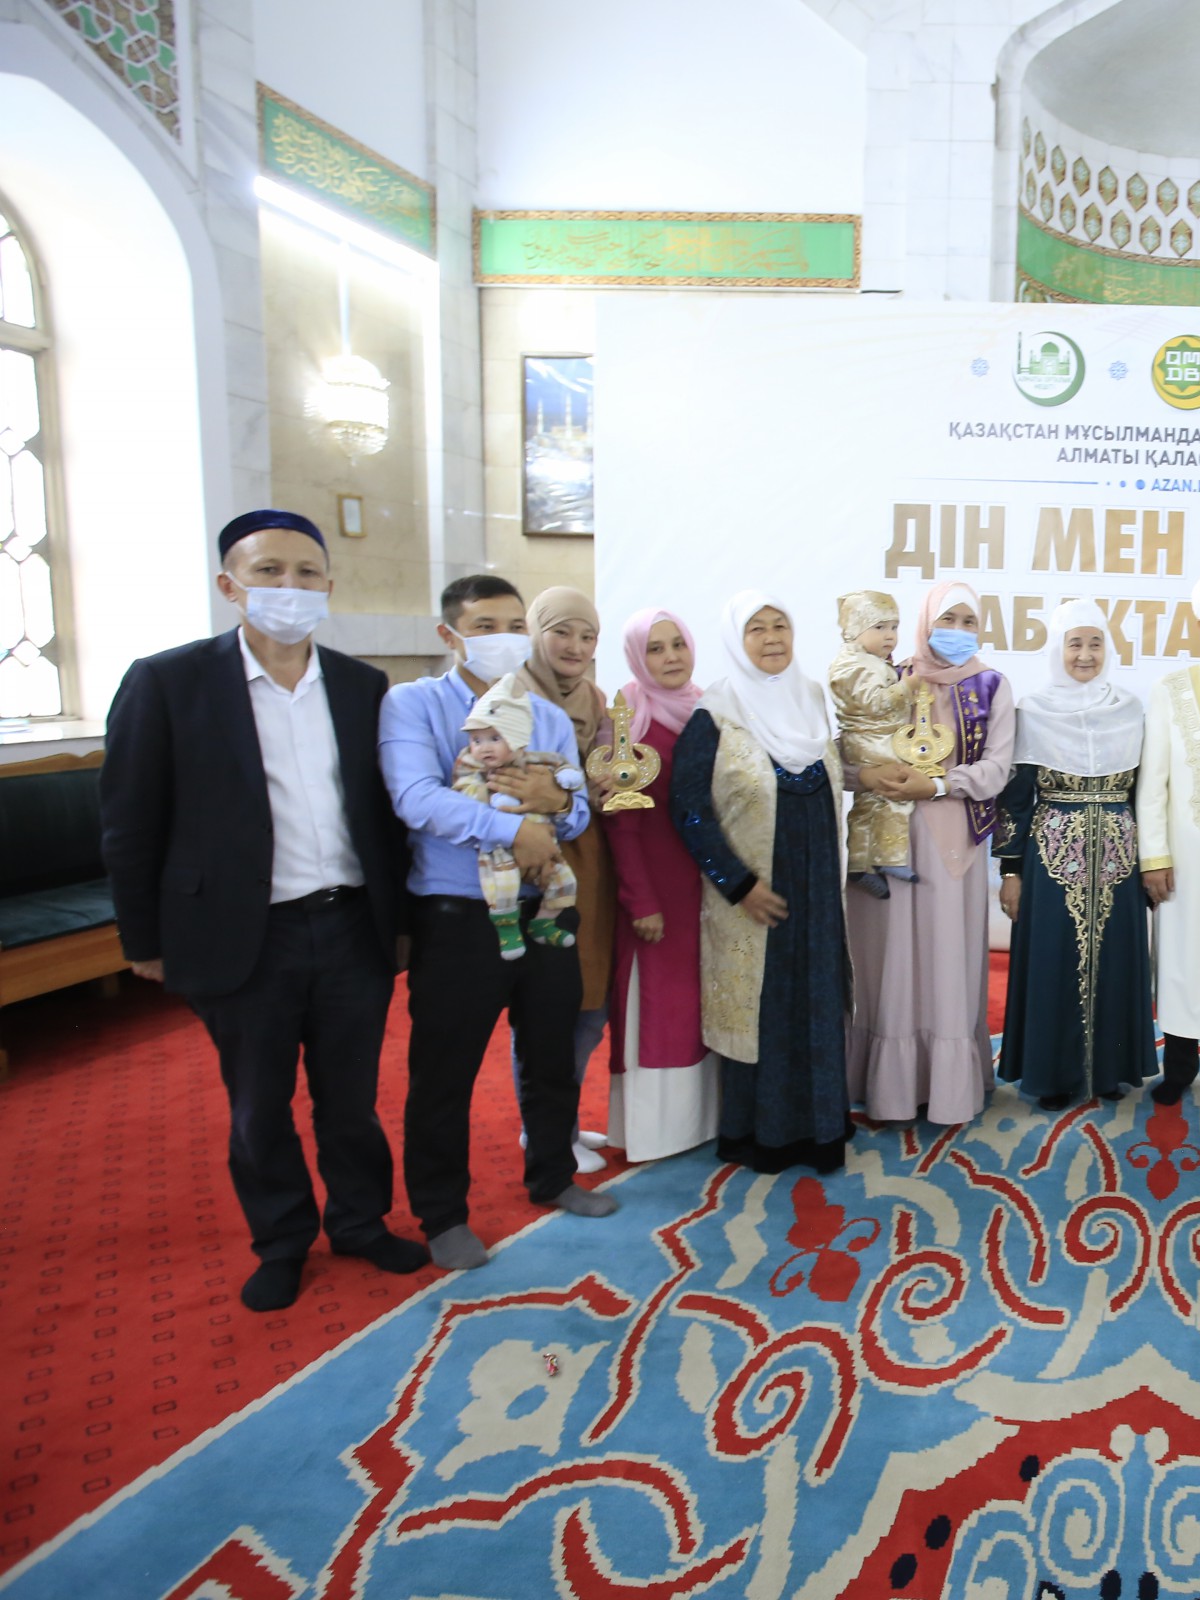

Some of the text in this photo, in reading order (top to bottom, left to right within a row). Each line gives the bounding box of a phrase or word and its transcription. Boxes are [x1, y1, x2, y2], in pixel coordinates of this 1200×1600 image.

[949, 421, 1059, 441] ҚАЗАҚСТАН
[1057, 447, 1140, 465] АЛМАТЫ
[885, 503, 1005, 580] ДІН
[1031, 507, 1185, 576] МЕН
